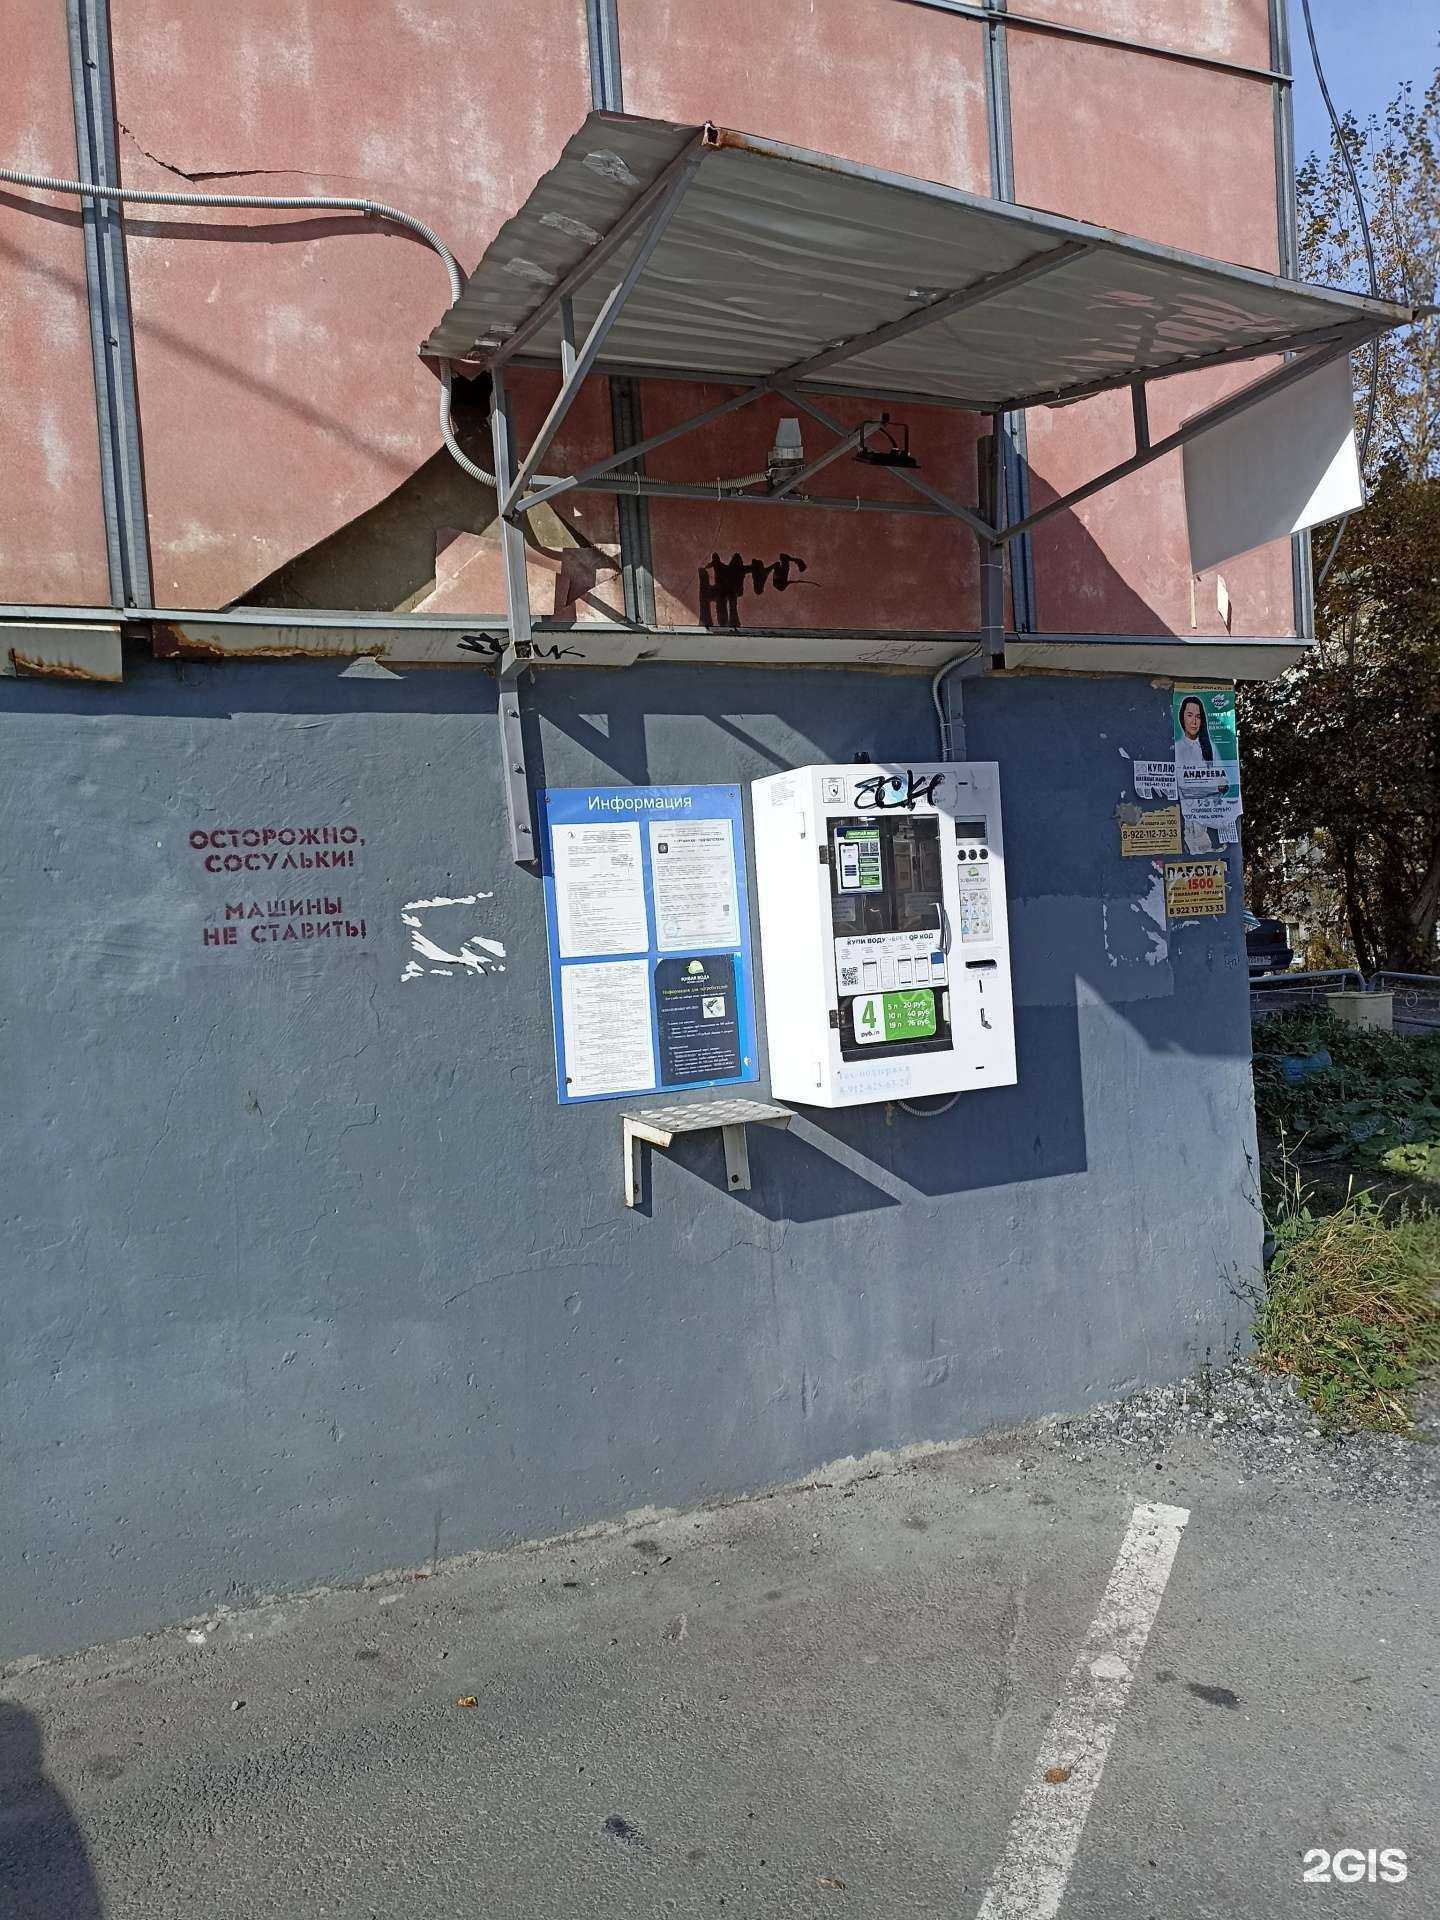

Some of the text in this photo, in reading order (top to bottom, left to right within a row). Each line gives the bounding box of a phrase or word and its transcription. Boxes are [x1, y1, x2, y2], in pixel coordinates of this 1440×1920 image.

[1147, 763, 1175, 773] КУПЛЮ
[1183, 769, 1227, 779] АНДРЕЕВА
[587, 794, 693, 812] Информация
[188, 825, 366, 850] ОСТОРОЖНО,
[1122, 829, 1178, 840] 8-922-112-73-33
[203, 850, 355, 873] СОСУЛЬКИ!
[1188, 877, 1214, 890] 1500
[225, 897, 342, 921] МАШИНЫ
[203, 919, 367, 947] НЕ СТАВИТЬ!
[867, 936, 886, 944] ВОДУ
[919, 932, 934, 940] КОД
[862, 1000, 877, 1028] 4
